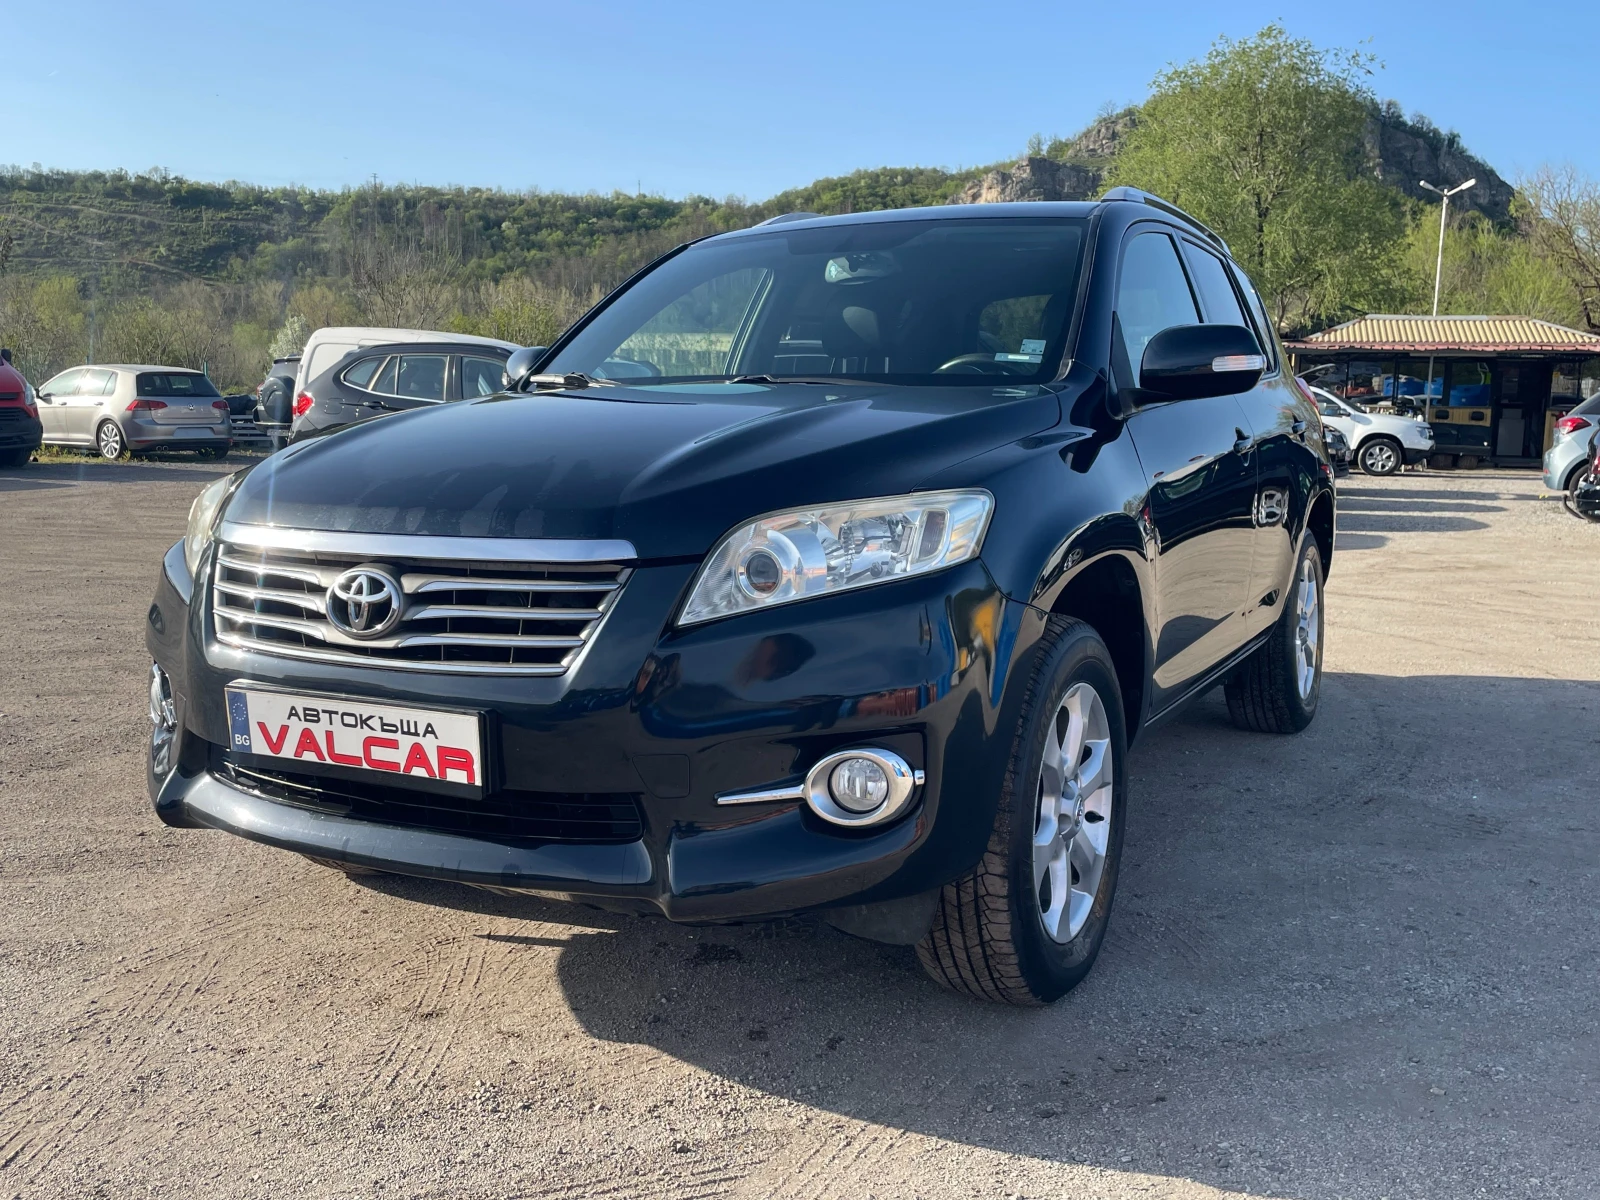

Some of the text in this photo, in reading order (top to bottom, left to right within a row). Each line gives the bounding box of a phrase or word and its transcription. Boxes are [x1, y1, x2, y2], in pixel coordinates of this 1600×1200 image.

[287, 705, 439, 739] АВТОКЪЩА
[235, 734, 250, 746] BG
[257, 721, 475, 784] VALCAR
